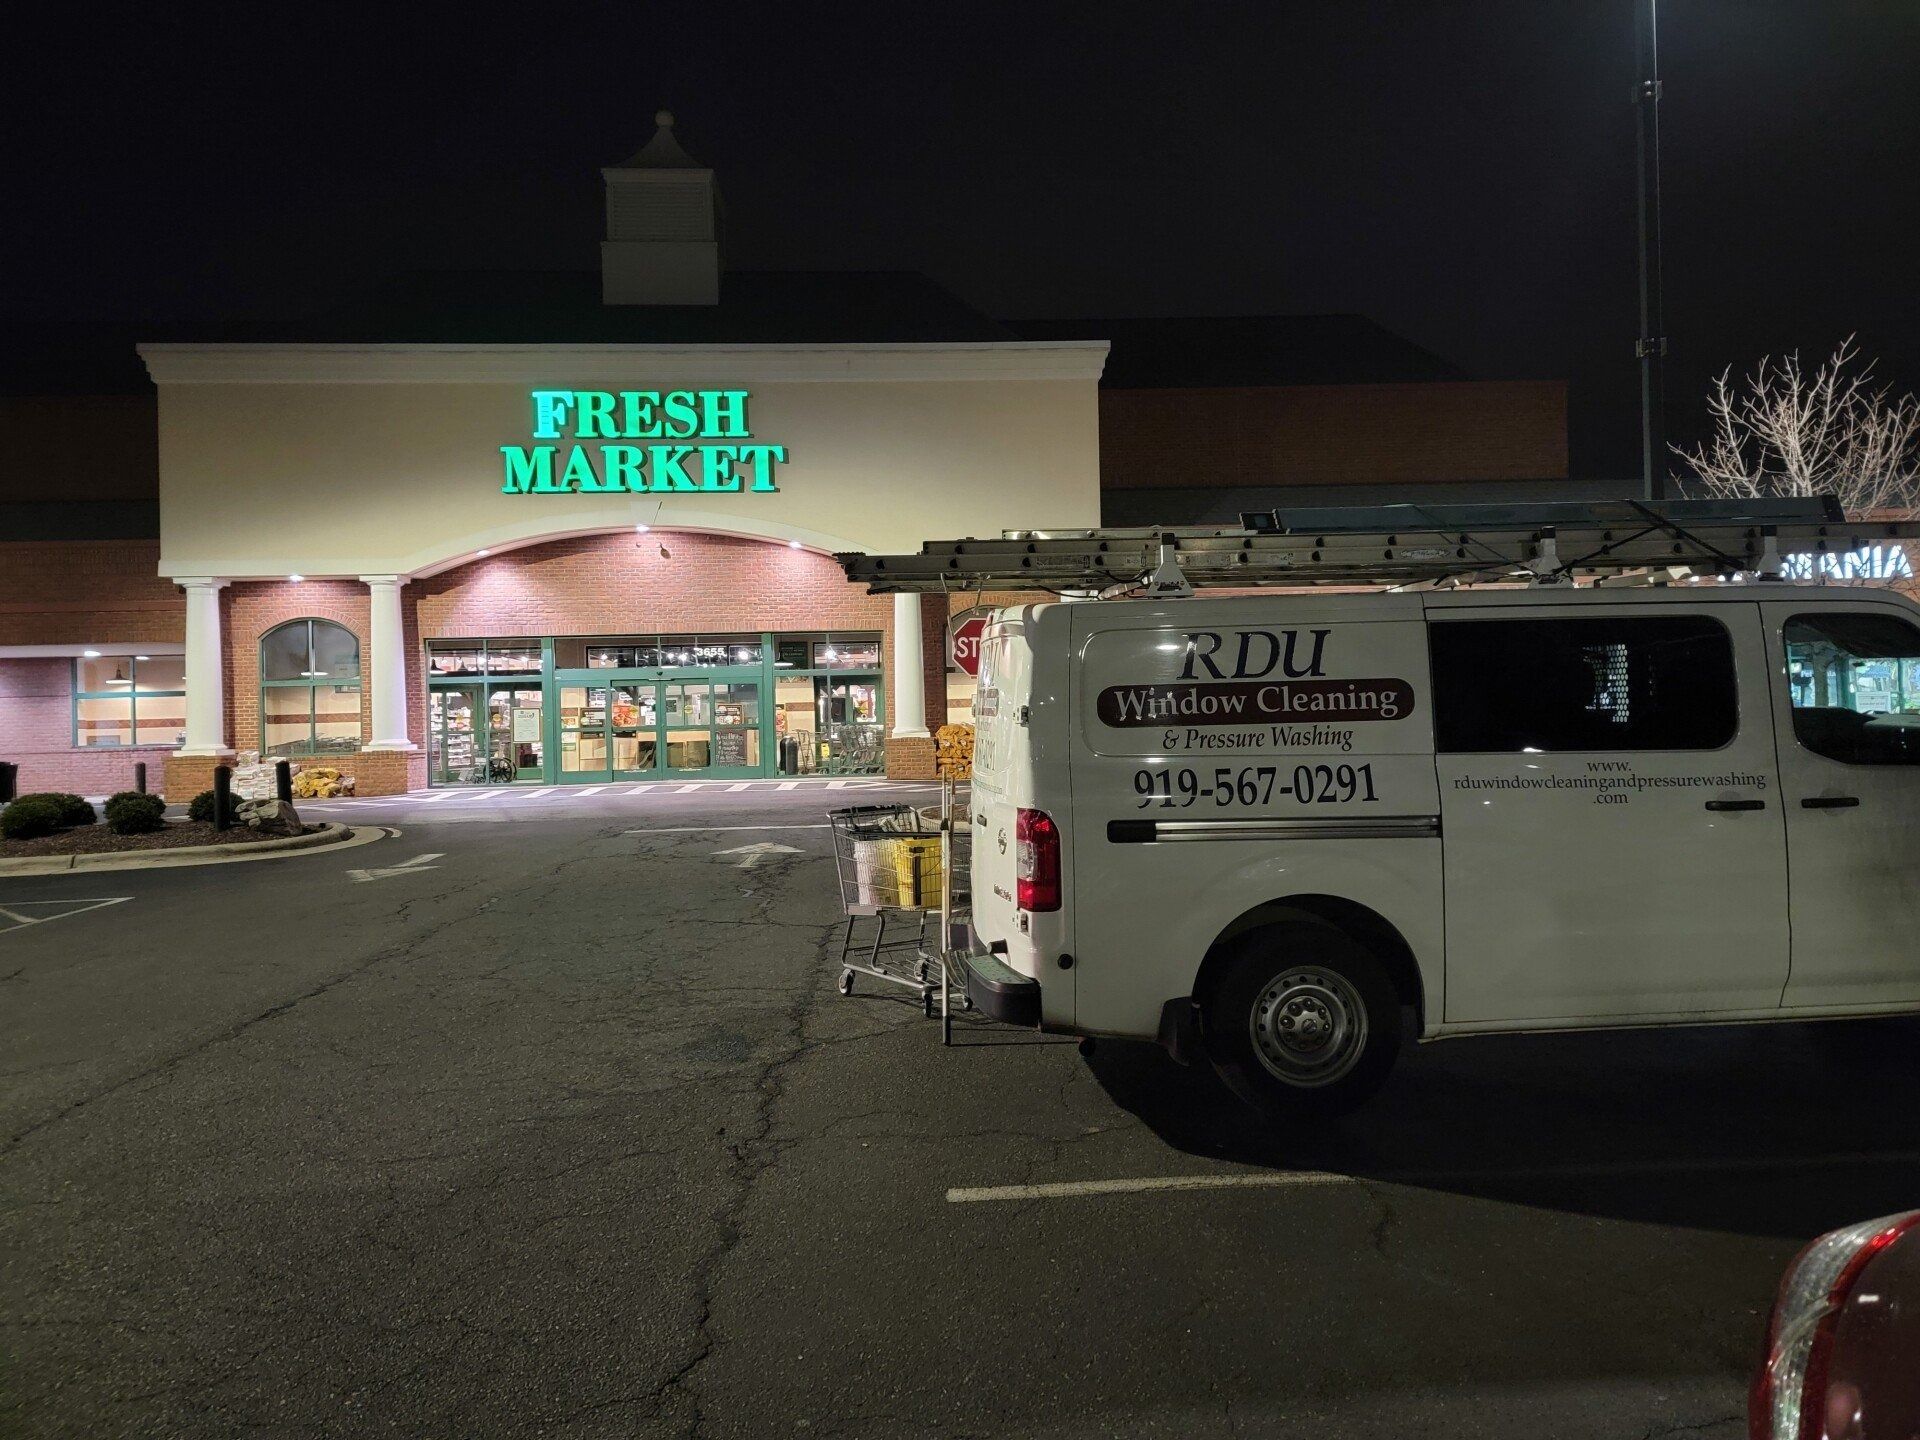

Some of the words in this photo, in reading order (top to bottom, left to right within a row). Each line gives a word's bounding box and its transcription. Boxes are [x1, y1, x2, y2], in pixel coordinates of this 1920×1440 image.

[531, 390, 750, 438] FRESH
[499, 444, 785, 493] MARKET
[694, 647, 725, 657] 3655
[956, 636, 980, 658] ST
[1176, 629, 1332, 681] RDU
[1113, 685, 1248, 722] Window
[1256, 682, 1399, 718] Cleaning
[1162, 728, 1180, 750] &
[1183, 728, 1265, 750] Pressure
[1270, 724, 1354, 751] Washing
[1587, 760, 1632, 773] www.
[1134, 763, 1379, 809] 919-567-0291
[1454, 771, 1767, 791] rduwindowcleaningandpressurewashing
[1592, 789, 1630, 805] .com
